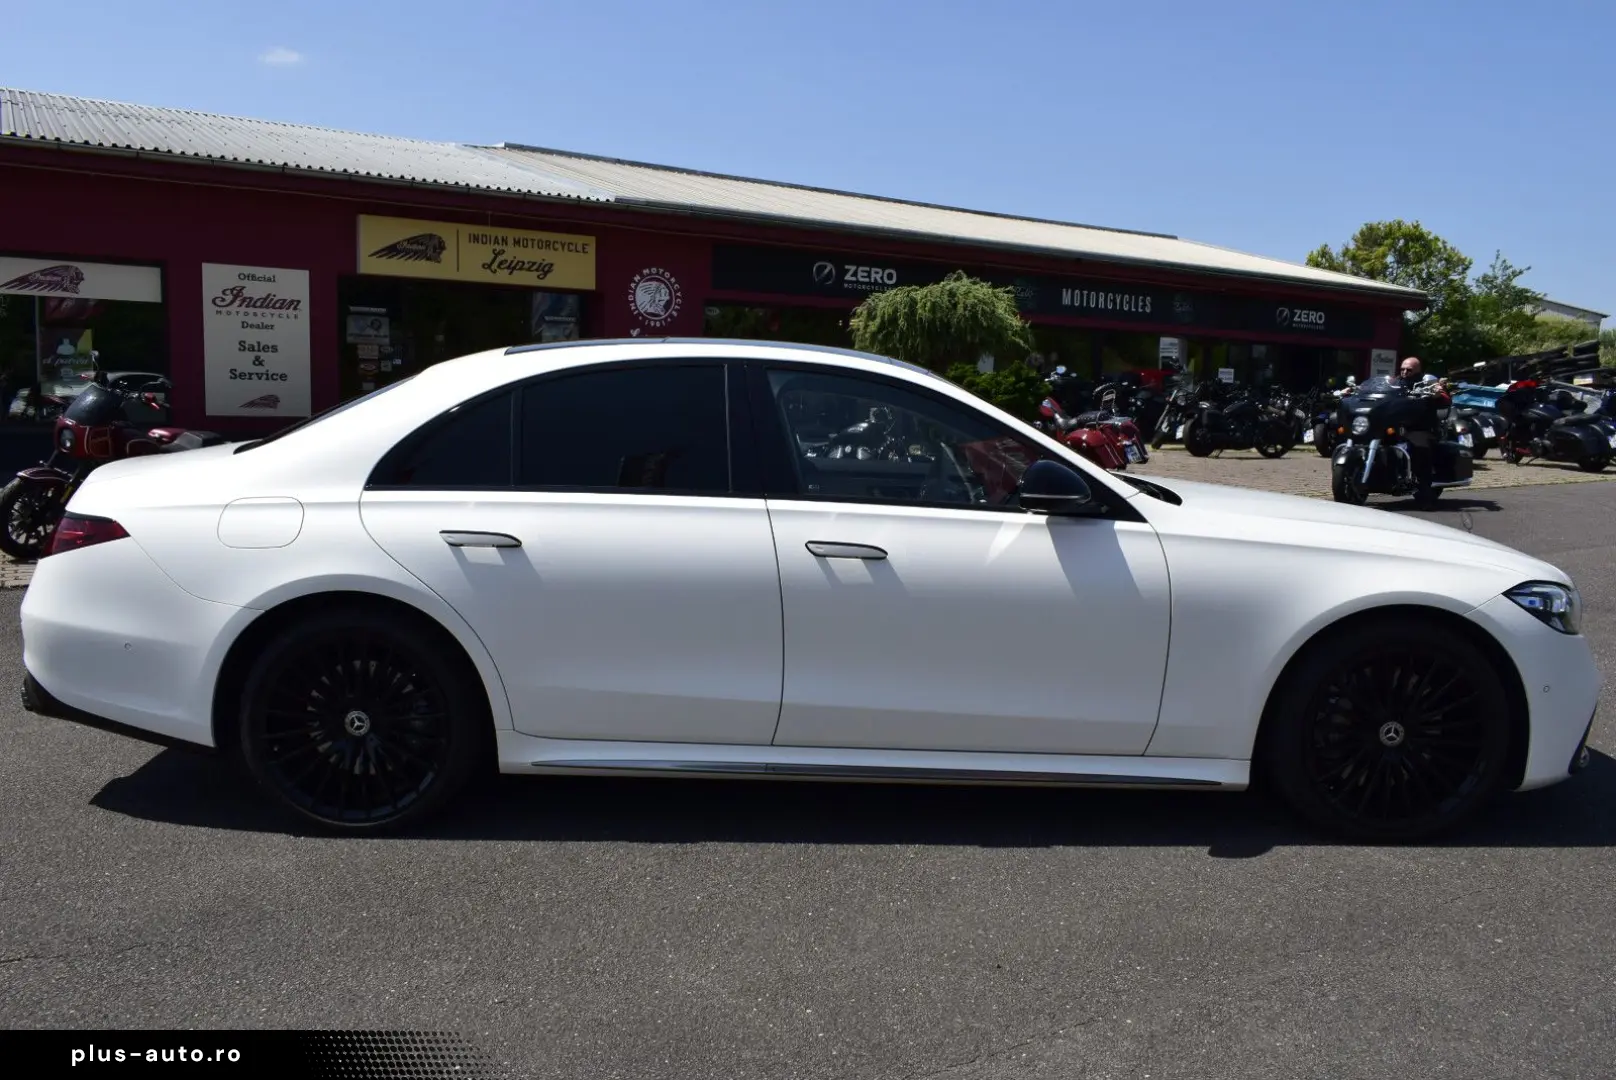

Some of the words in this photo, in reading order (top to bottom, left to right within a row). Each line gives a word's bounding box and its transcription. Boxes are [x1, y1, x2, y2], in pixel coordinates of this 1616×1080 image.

[468, 232, 509, 247] INDIAN
[513, 236, 590, 254] MOTORCYCLE
[481, 248, 555, 280] Leipzig
[238, 272, 276, 283] Official
[843, 264, 898, 285] ZERO
[211, 285, 302, 311] Indian
[643, 267, 682, 317] MOTORCYCLE
[1062, 287, 1152, 313] MOTORCYCLES
[215, 309, 299, 320] MOTORCYCLE
[1293, 309, 1326, 324] ZERO
[241, 320, 275, 331] Dealer
[237, 340, 279, 353] Sales
[252, 355, 265, 367] &
[229, 368, 288, 382] Service
